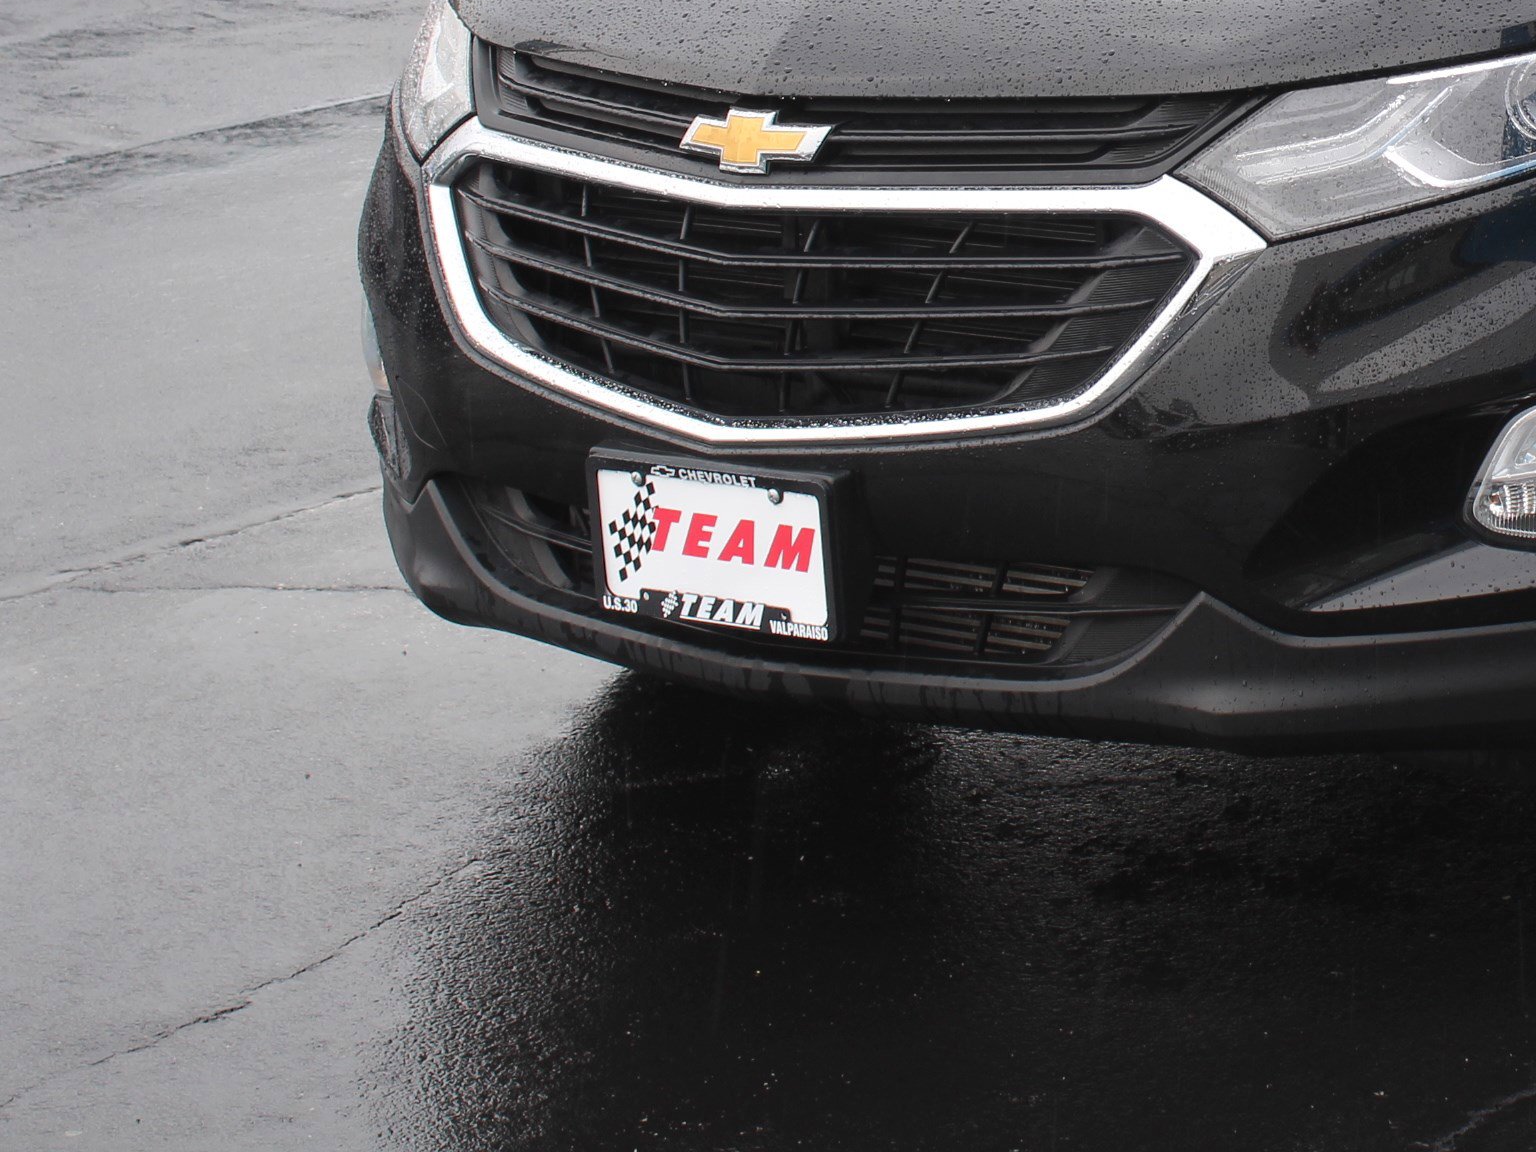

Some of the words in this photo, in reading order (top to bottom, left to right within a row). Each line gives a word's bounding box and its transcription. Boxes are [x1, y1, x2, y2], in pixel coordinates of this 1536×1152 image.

[678, 468, 756, 488] CHEVROLET
[651, 507, 815, 573] TEAM
[679, 593, 765, 630] TEAM
[769, 619, 829, 641] VALPARAISO
